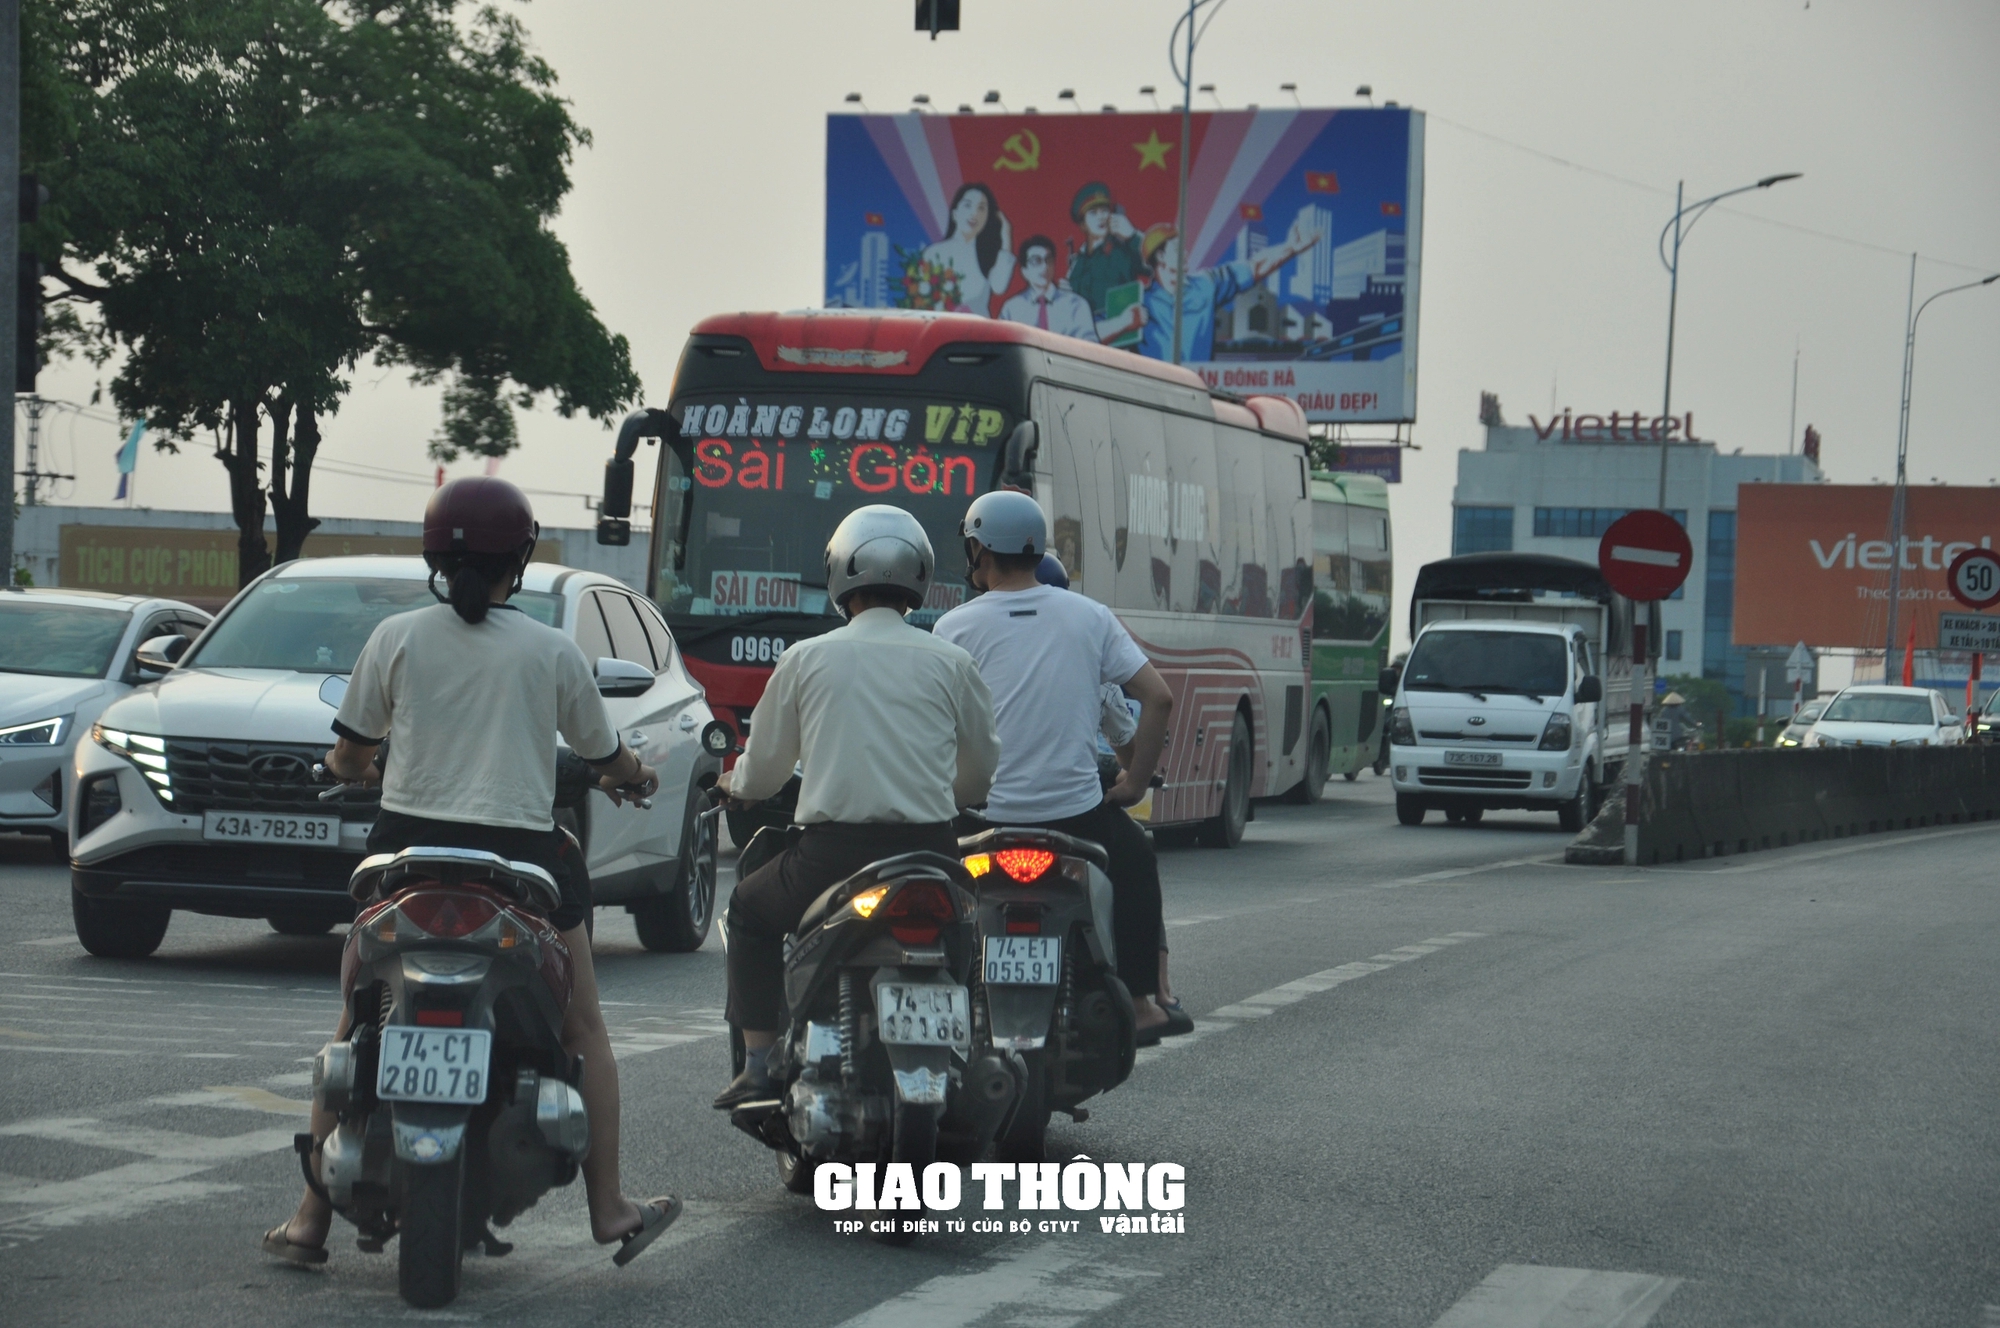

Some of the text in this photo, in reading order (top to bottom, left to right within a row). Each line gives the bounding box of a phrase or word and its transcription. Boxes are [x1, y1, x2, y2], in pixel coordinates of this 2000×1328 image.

[1224, 366, 1268, 386] ĐÔNG
[1273, 366, 1295, 386] HÀ
[1298, 390, 1378, 414] GIÀU ĐẸP!
[680, 397, 804, 437] HOÀNG
[807, 406, 911, 441] LONG
[1528, 406, 1702, 442] viettel
[695, 438, 785, 491] Sài
[76, 540, 236, 593] TÍCH CỰC PHÒN
[1966, 565, 1992, 592] 50
[714, 570, 749, 606] SÀI
[1943, 619, 1954, 630] XE
[731, 636, 785, 662] 0969
[1950, 635, 1960, 646] XE
[215, 817, 329, 840] 43A-782.93
[996, 938, 1048, 959] 74-E1
[987, 961, 1055, 983] 055.91
[400, 1031, 472, 1064] 74-C1
[381, 1065, 480, 1098] 280.78
